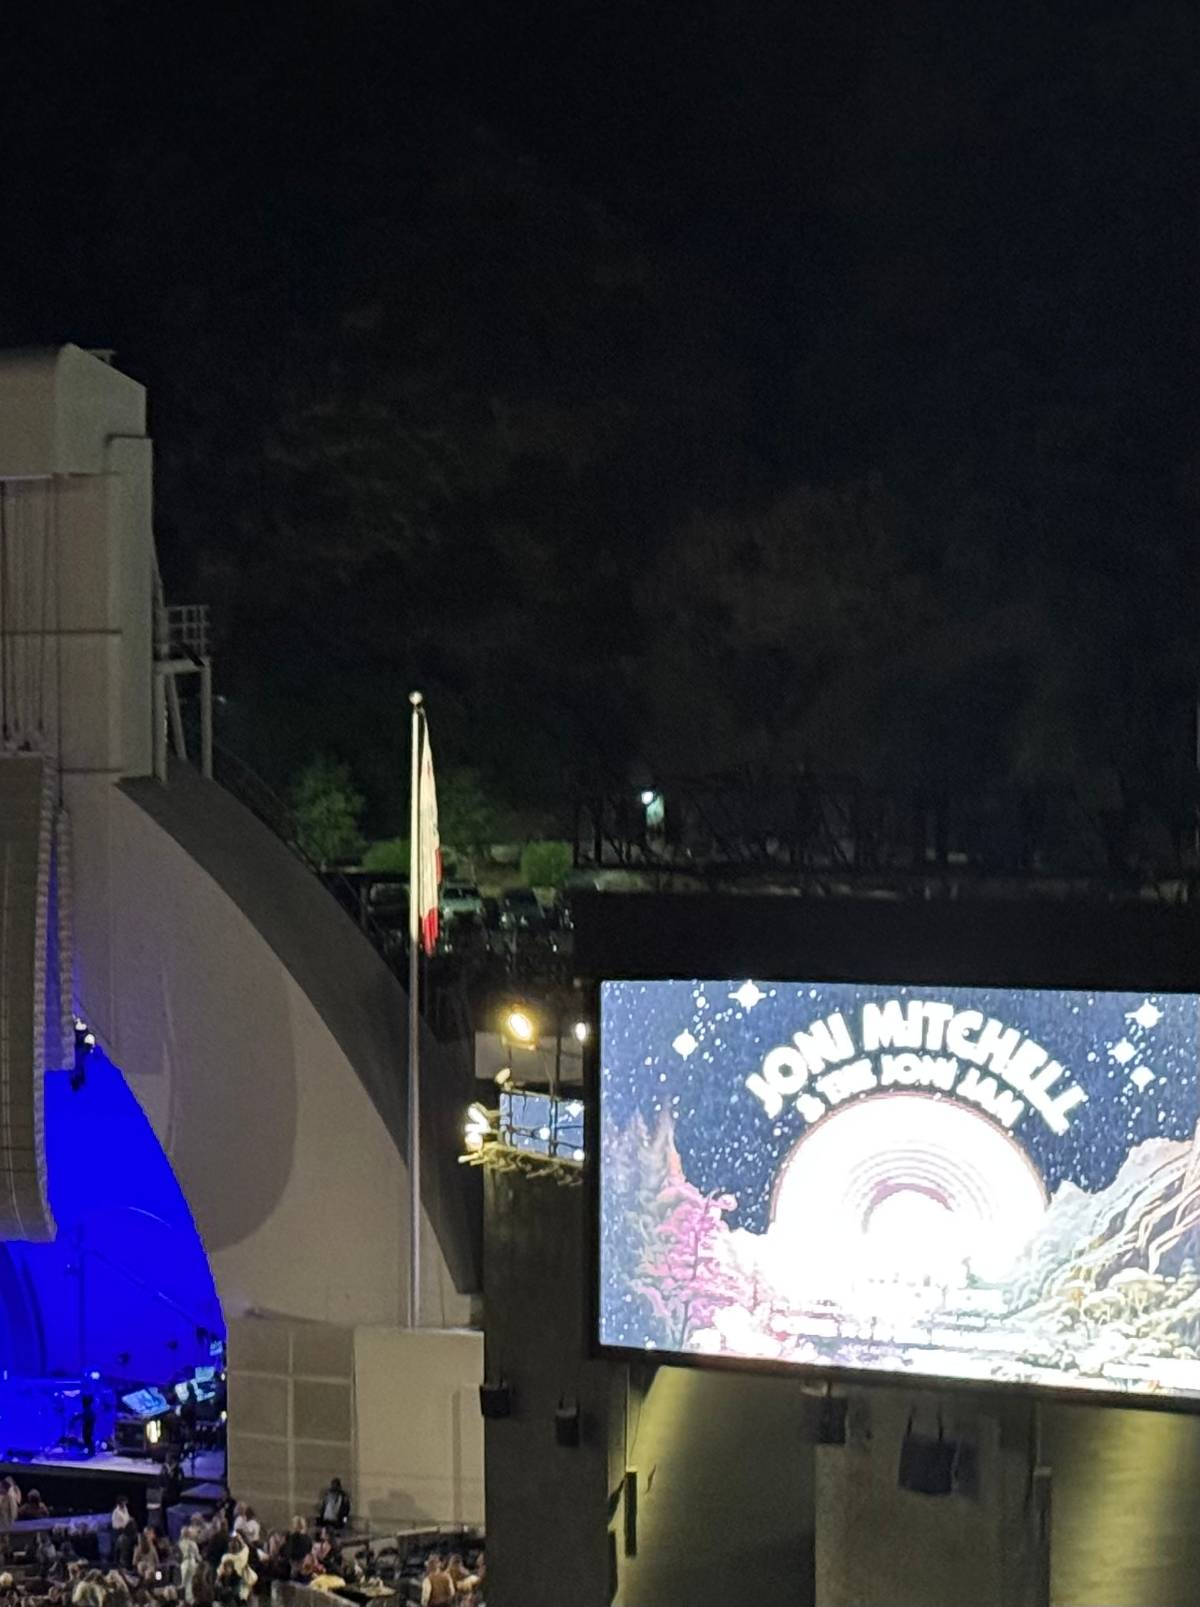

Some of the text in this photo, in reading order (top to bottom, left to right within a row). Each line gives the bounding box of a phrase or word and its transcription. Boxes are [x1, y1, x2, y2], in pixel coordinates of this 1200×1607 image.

[746, 1001, 1088, 1134] JONI MITCHELL
[957, 1068, 1024, 1127] JAM
